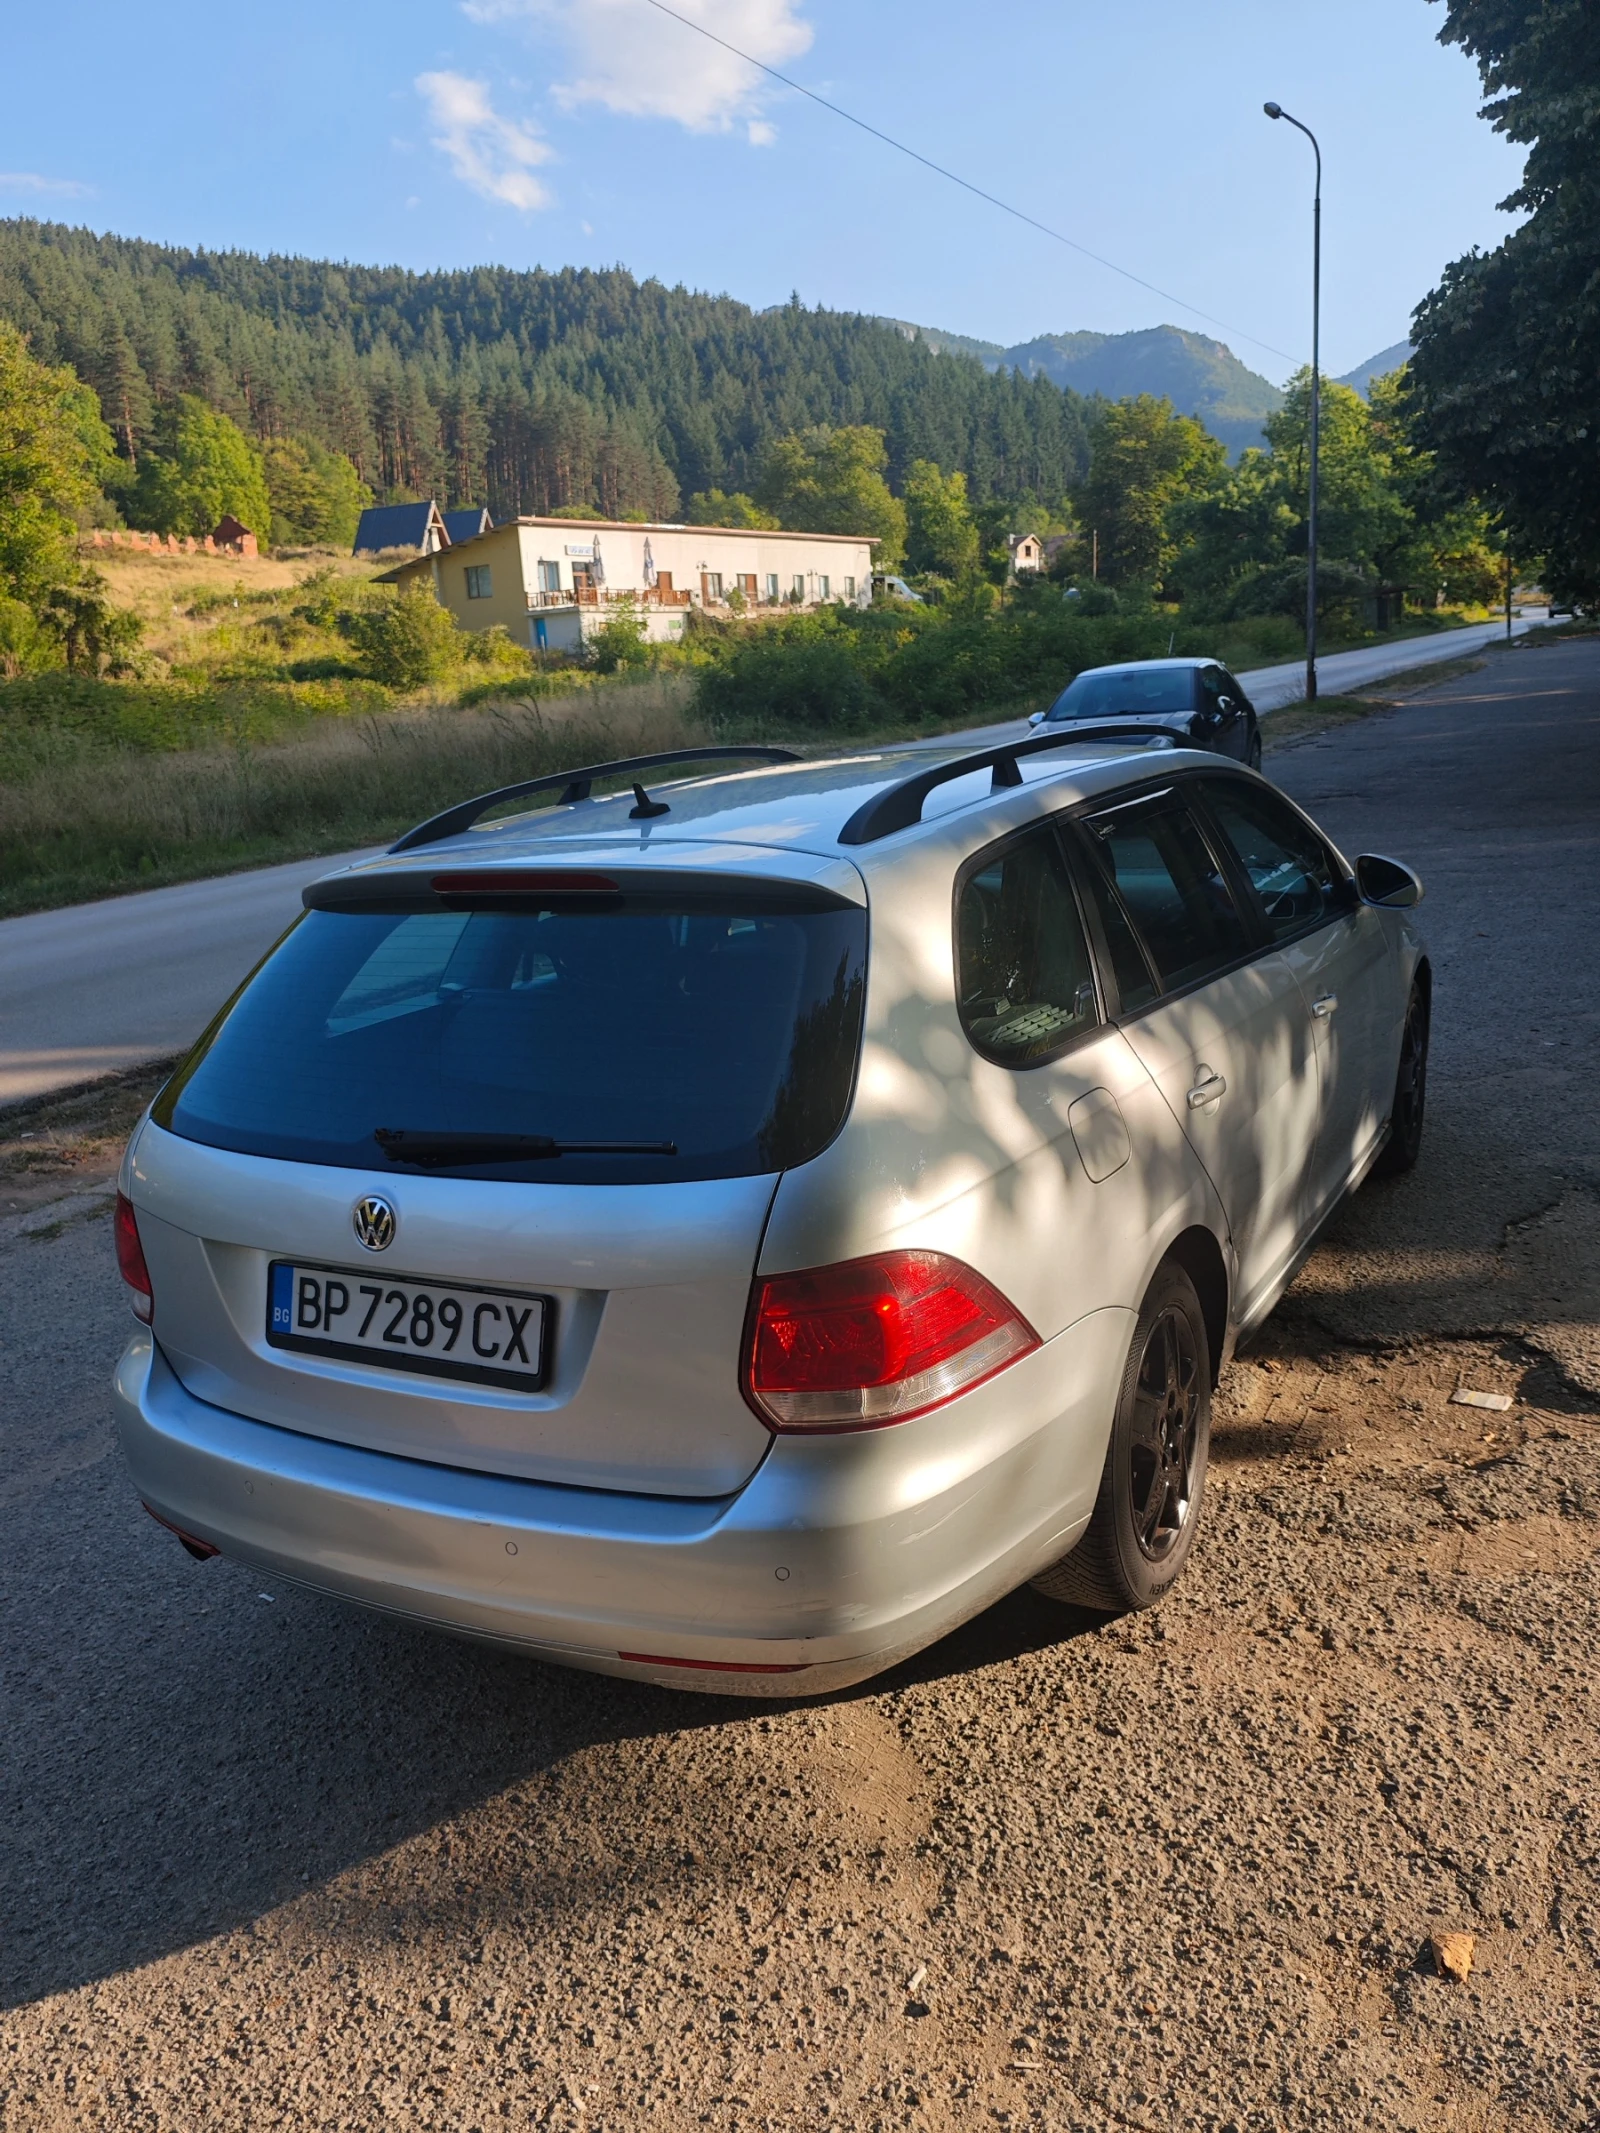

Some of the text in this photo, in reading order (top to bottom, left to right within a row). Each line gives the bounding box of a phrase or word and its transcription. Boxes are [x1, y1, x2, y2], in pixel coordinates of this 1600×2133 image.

[355, 1197, 393, 1250] VW
[274, 1306, 290, 1324] BG
[297, 1276, 534, 1364] BP 7289 CX
